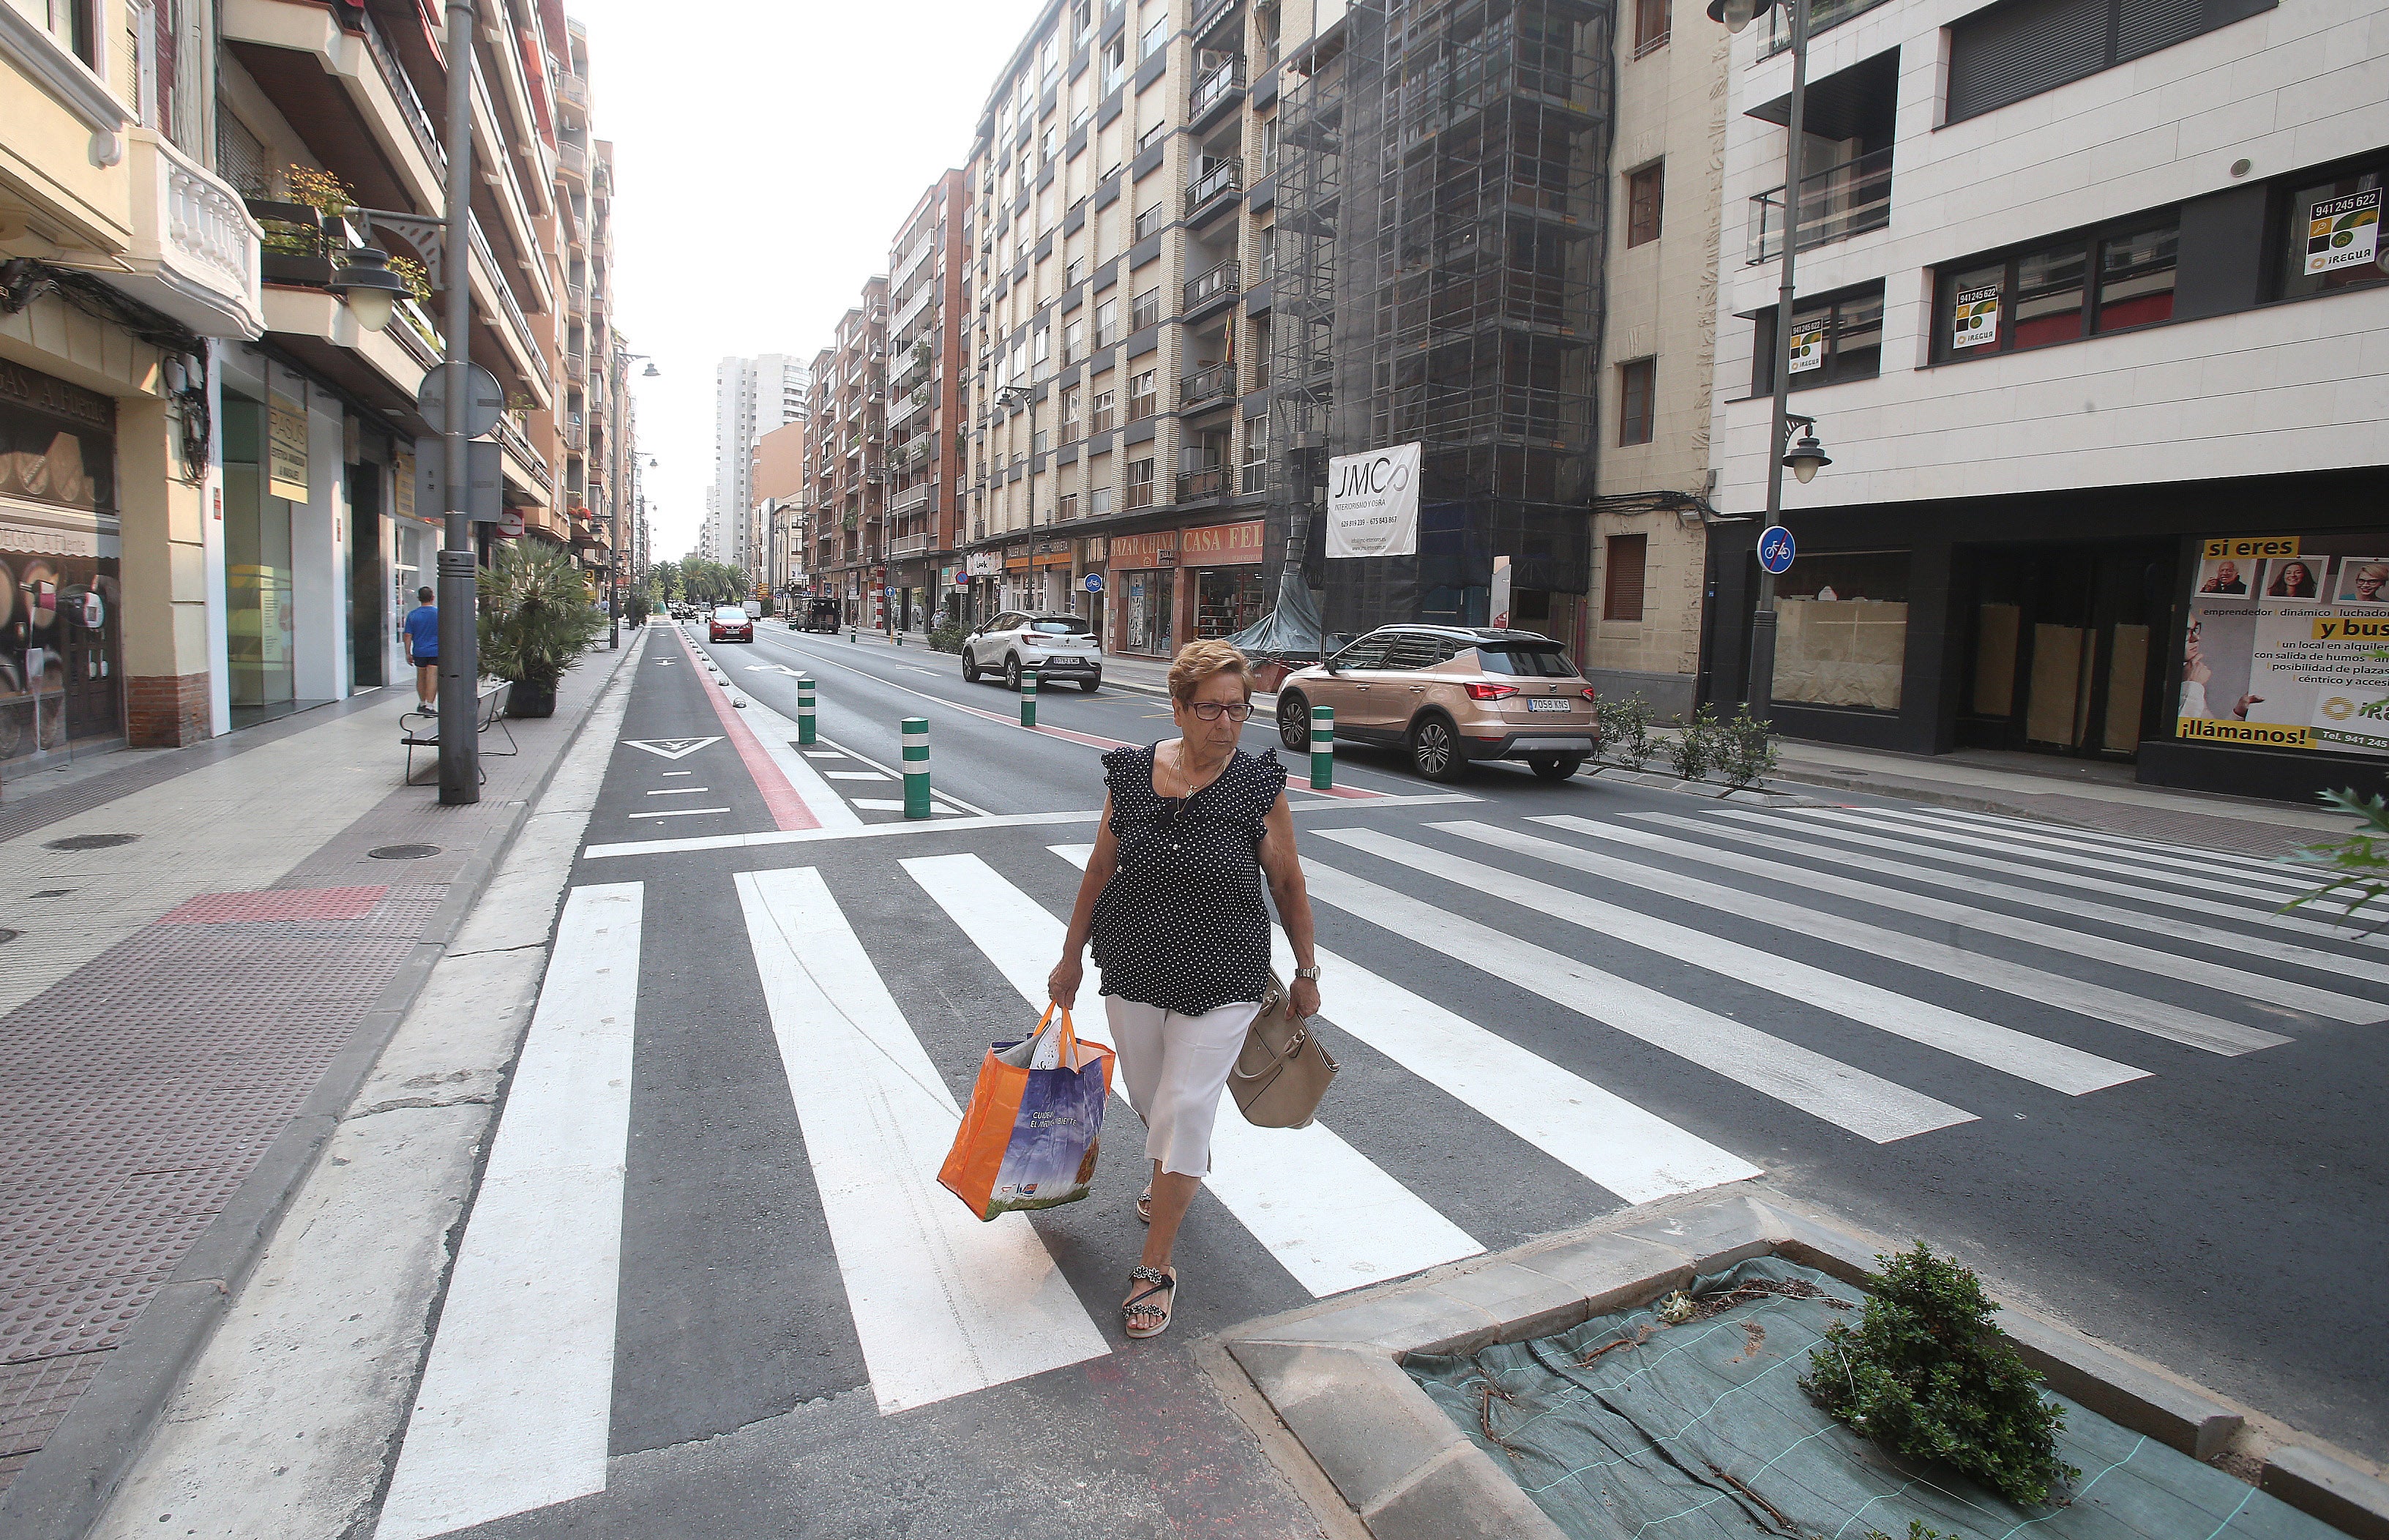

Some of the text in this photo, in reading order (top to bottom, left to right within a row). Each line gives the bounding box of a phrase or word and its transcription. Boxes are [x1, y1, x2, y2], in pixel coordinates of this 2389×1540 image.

[2316, 194, 2375, 216] 941 245 622
[1960, 288, 1996, 303] 941 245 622
[1334, 501, 1367, 512] INTERIORISMO
[1372, 498, 1386, 507] OBRA
[1110, 538, 1139, 557] BAZAR
[1183, 530, 1221, 553] CASA
[2208, 539, 2292, 556] si eres
[1007, 547, 1020, 557] TALLER
[2204, 609, 2273, 617] emprendedor
[2280, 608, 2330, 617] dinámico
[2321, 622, 2336, 639] y
[2299, 641, 2324, 649] local
[2344, 643, 2389, 652] alquiler
[2326, 654, 2365, 662] humos
[2272, 663, 2333, 672] posibilidad
[2336, 665, 2350, 673] de
[2298, 675, 2343, 684] céntrico
[2346, 678, 2353, 687] y
[1533, 700, 1569, 709] 7058 KNS
[2183, 720, 2306, 745] ¡llámanos!
[2322, 730, 2388, 748] Tel. 941 245
